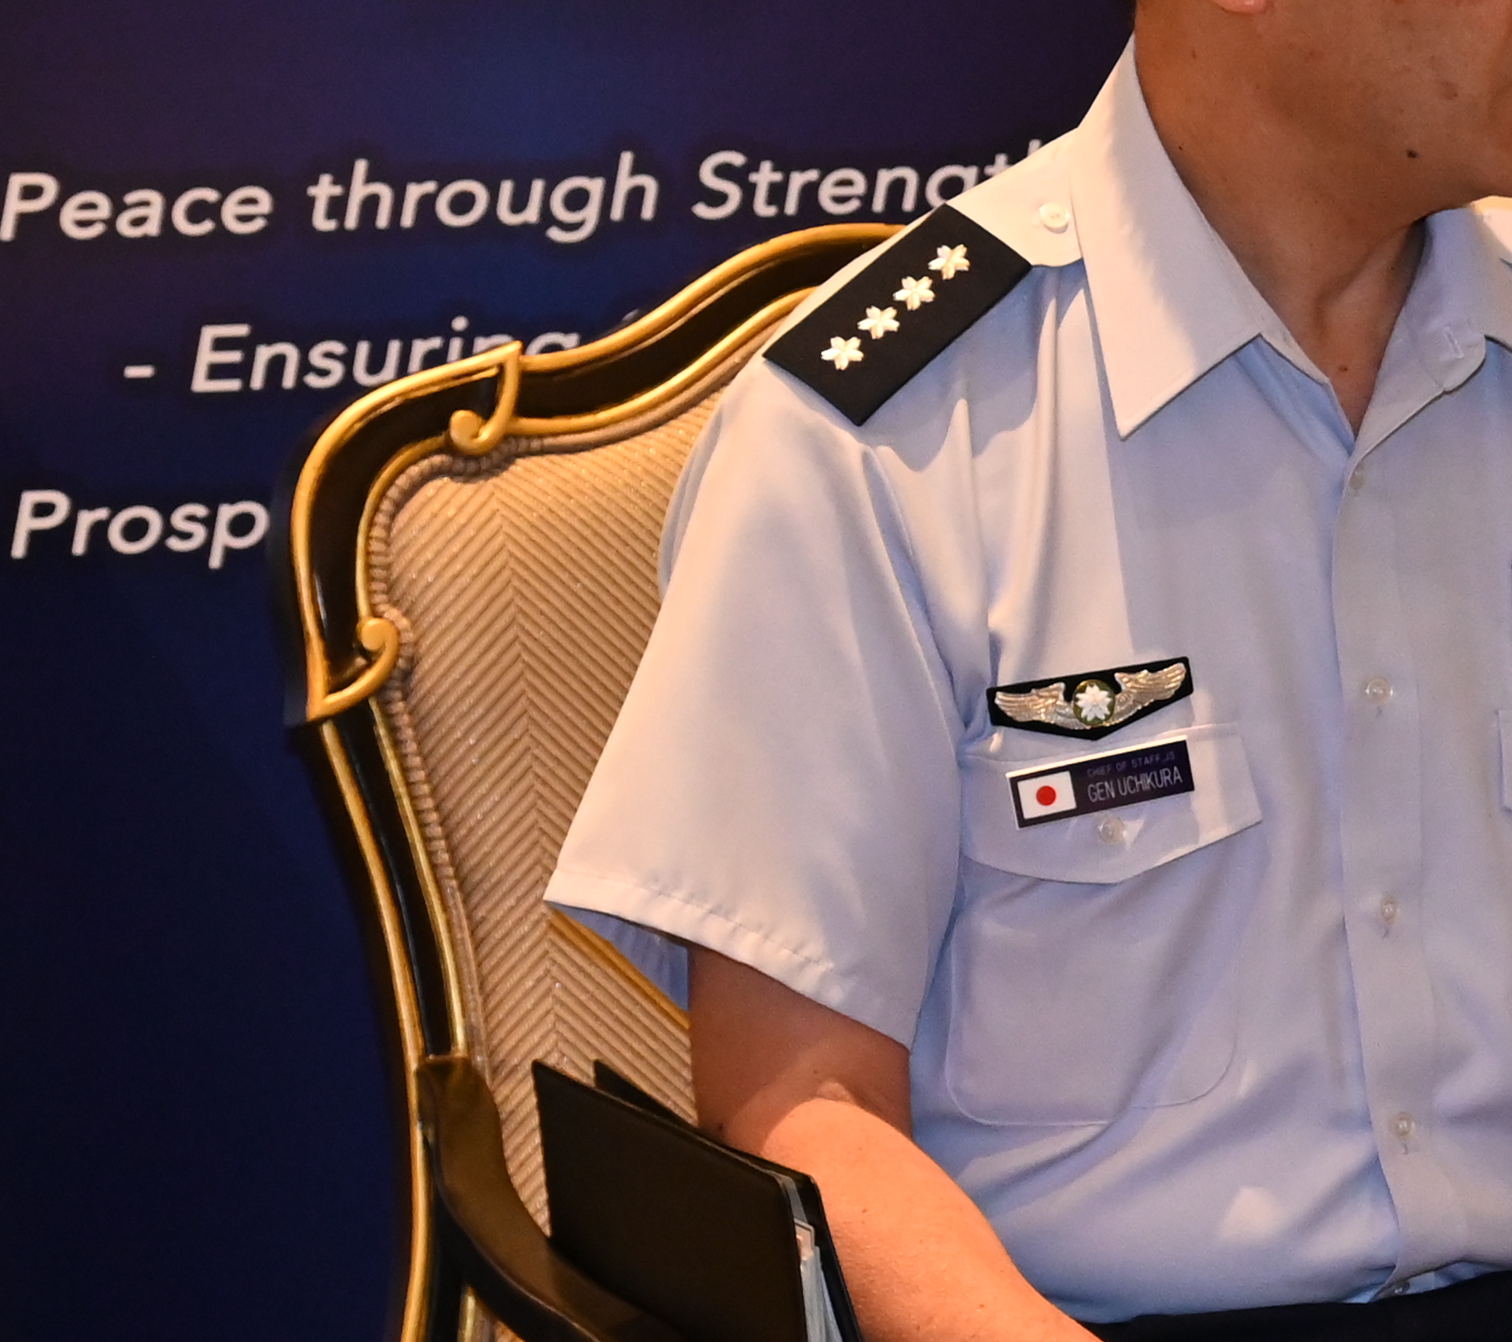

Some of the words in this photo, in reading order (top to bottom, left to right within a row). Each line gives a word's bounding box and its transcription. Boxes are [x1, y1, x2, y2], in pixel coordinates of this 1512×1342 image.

[0, 171, 274, 245] Peace
[307, 150, 659, 245] through
[124, 364, 155, 379] -
[1087, 780, 1115, 802] GEN
[1117, 765, 1183, 796] UCHIKURA
